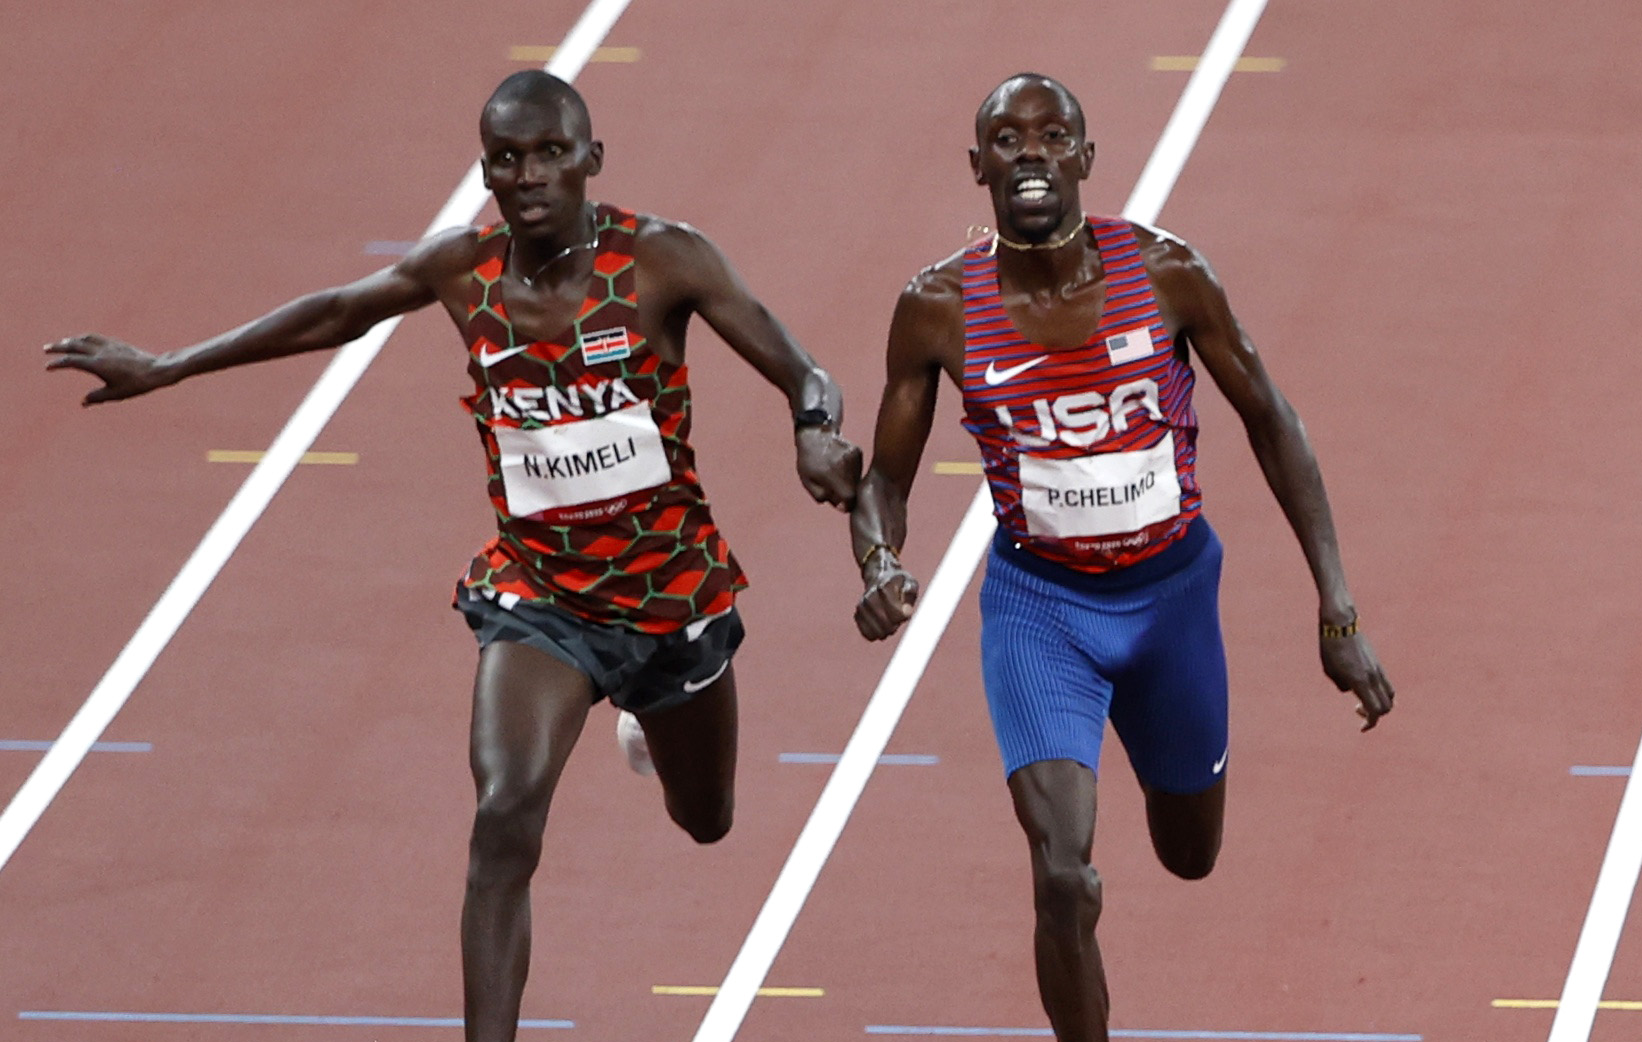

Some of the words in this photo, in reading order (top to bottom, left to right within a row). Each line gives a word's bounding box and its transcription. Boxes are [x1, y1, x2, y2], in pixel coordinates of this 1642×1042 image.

[490, 377, 640, 420] KENYA
[995, 377, 1164, 447] USA
[523, 436, 636, 480] N.KIMELI
[1047, 470, 1156, 508] P.CHELIMO
